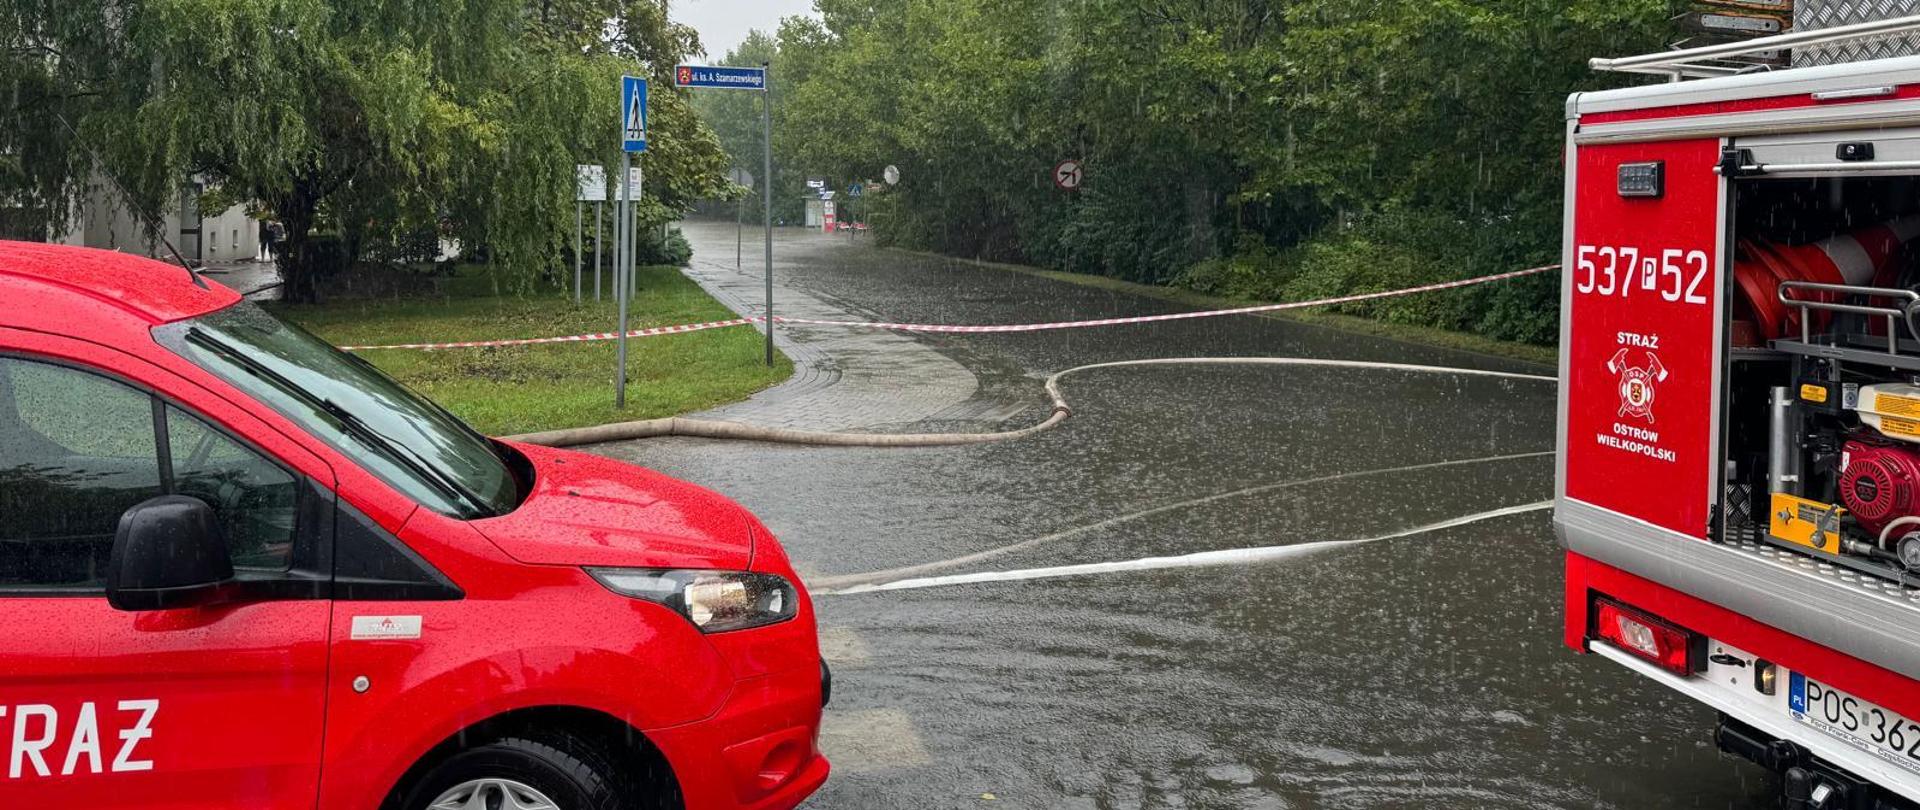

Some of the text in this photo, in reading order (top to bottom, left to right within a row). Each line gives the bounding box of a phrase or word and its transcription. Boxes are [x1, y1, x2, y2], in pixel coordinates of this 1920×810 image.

[1617, 331, 1659, 349] STRAŻ
[1613, 422, 1658, 443] OSTRÓW
[1596, 433, 1676, 462] WIELKOPOLSKI
[1793, 695, 1804, 706] PL
[1806, 680, 1858, 731] POS
